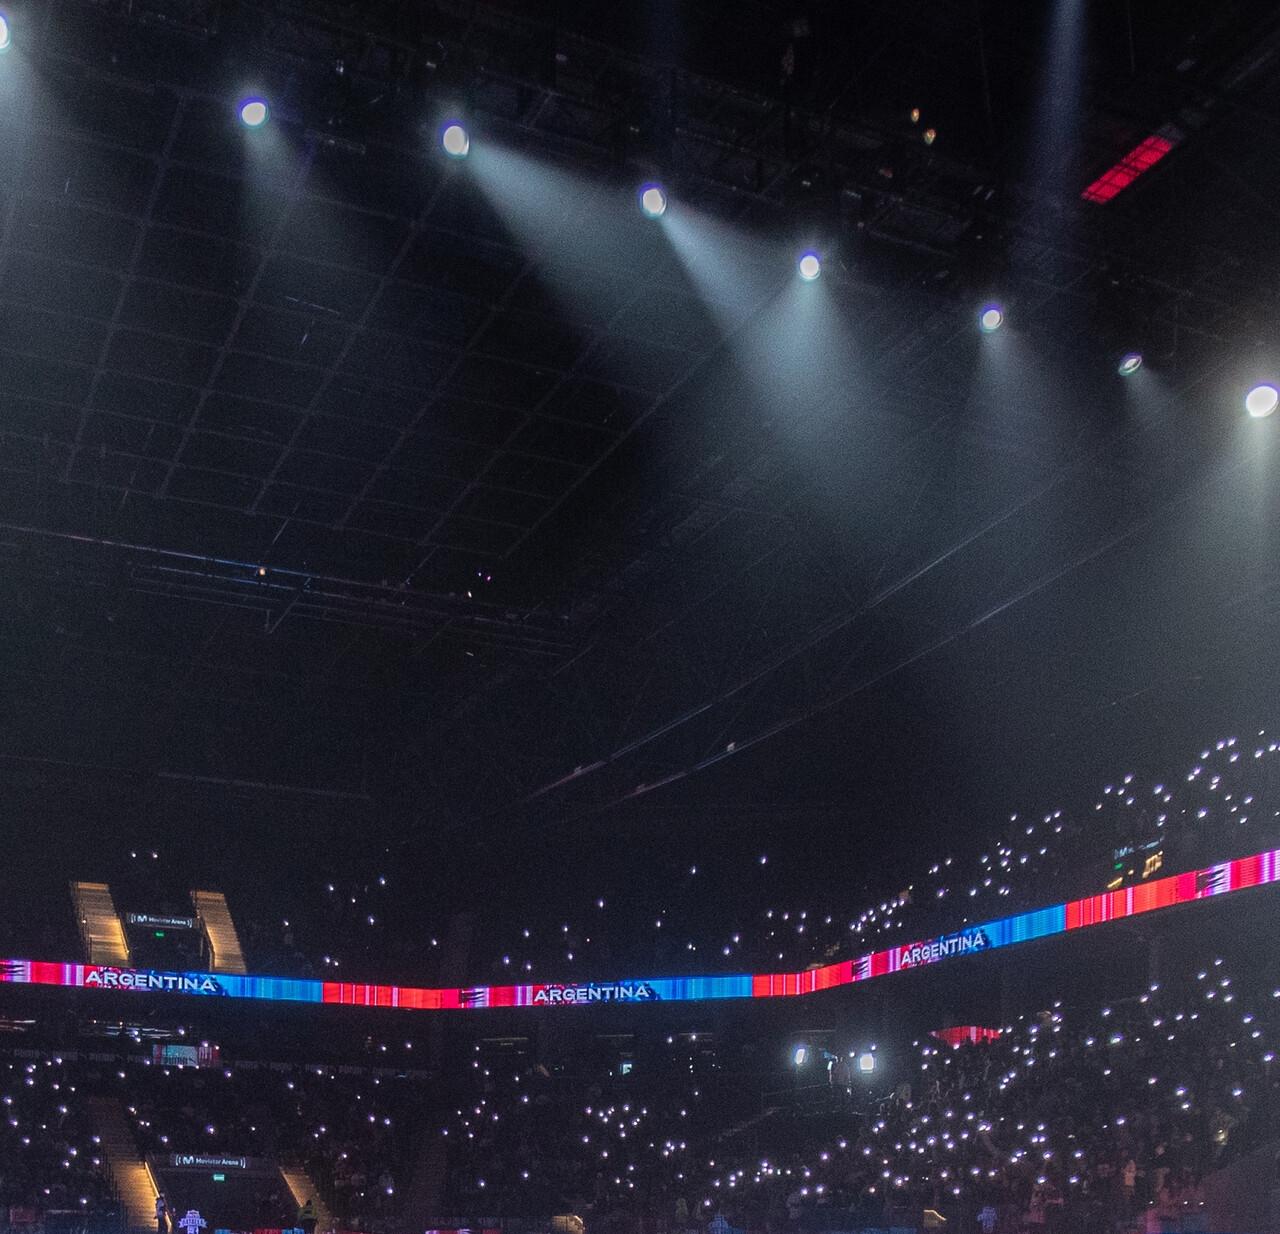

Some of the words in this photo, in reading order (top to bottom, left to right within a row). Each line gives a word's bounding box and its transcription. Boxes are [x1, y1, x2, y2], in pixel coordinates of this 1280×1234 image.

[901, 931, 985, 965] ARGENTINA
[85, 970, 217, 992] ARGENTINA
[534, 985, 650, 1002] ARGENTINA
